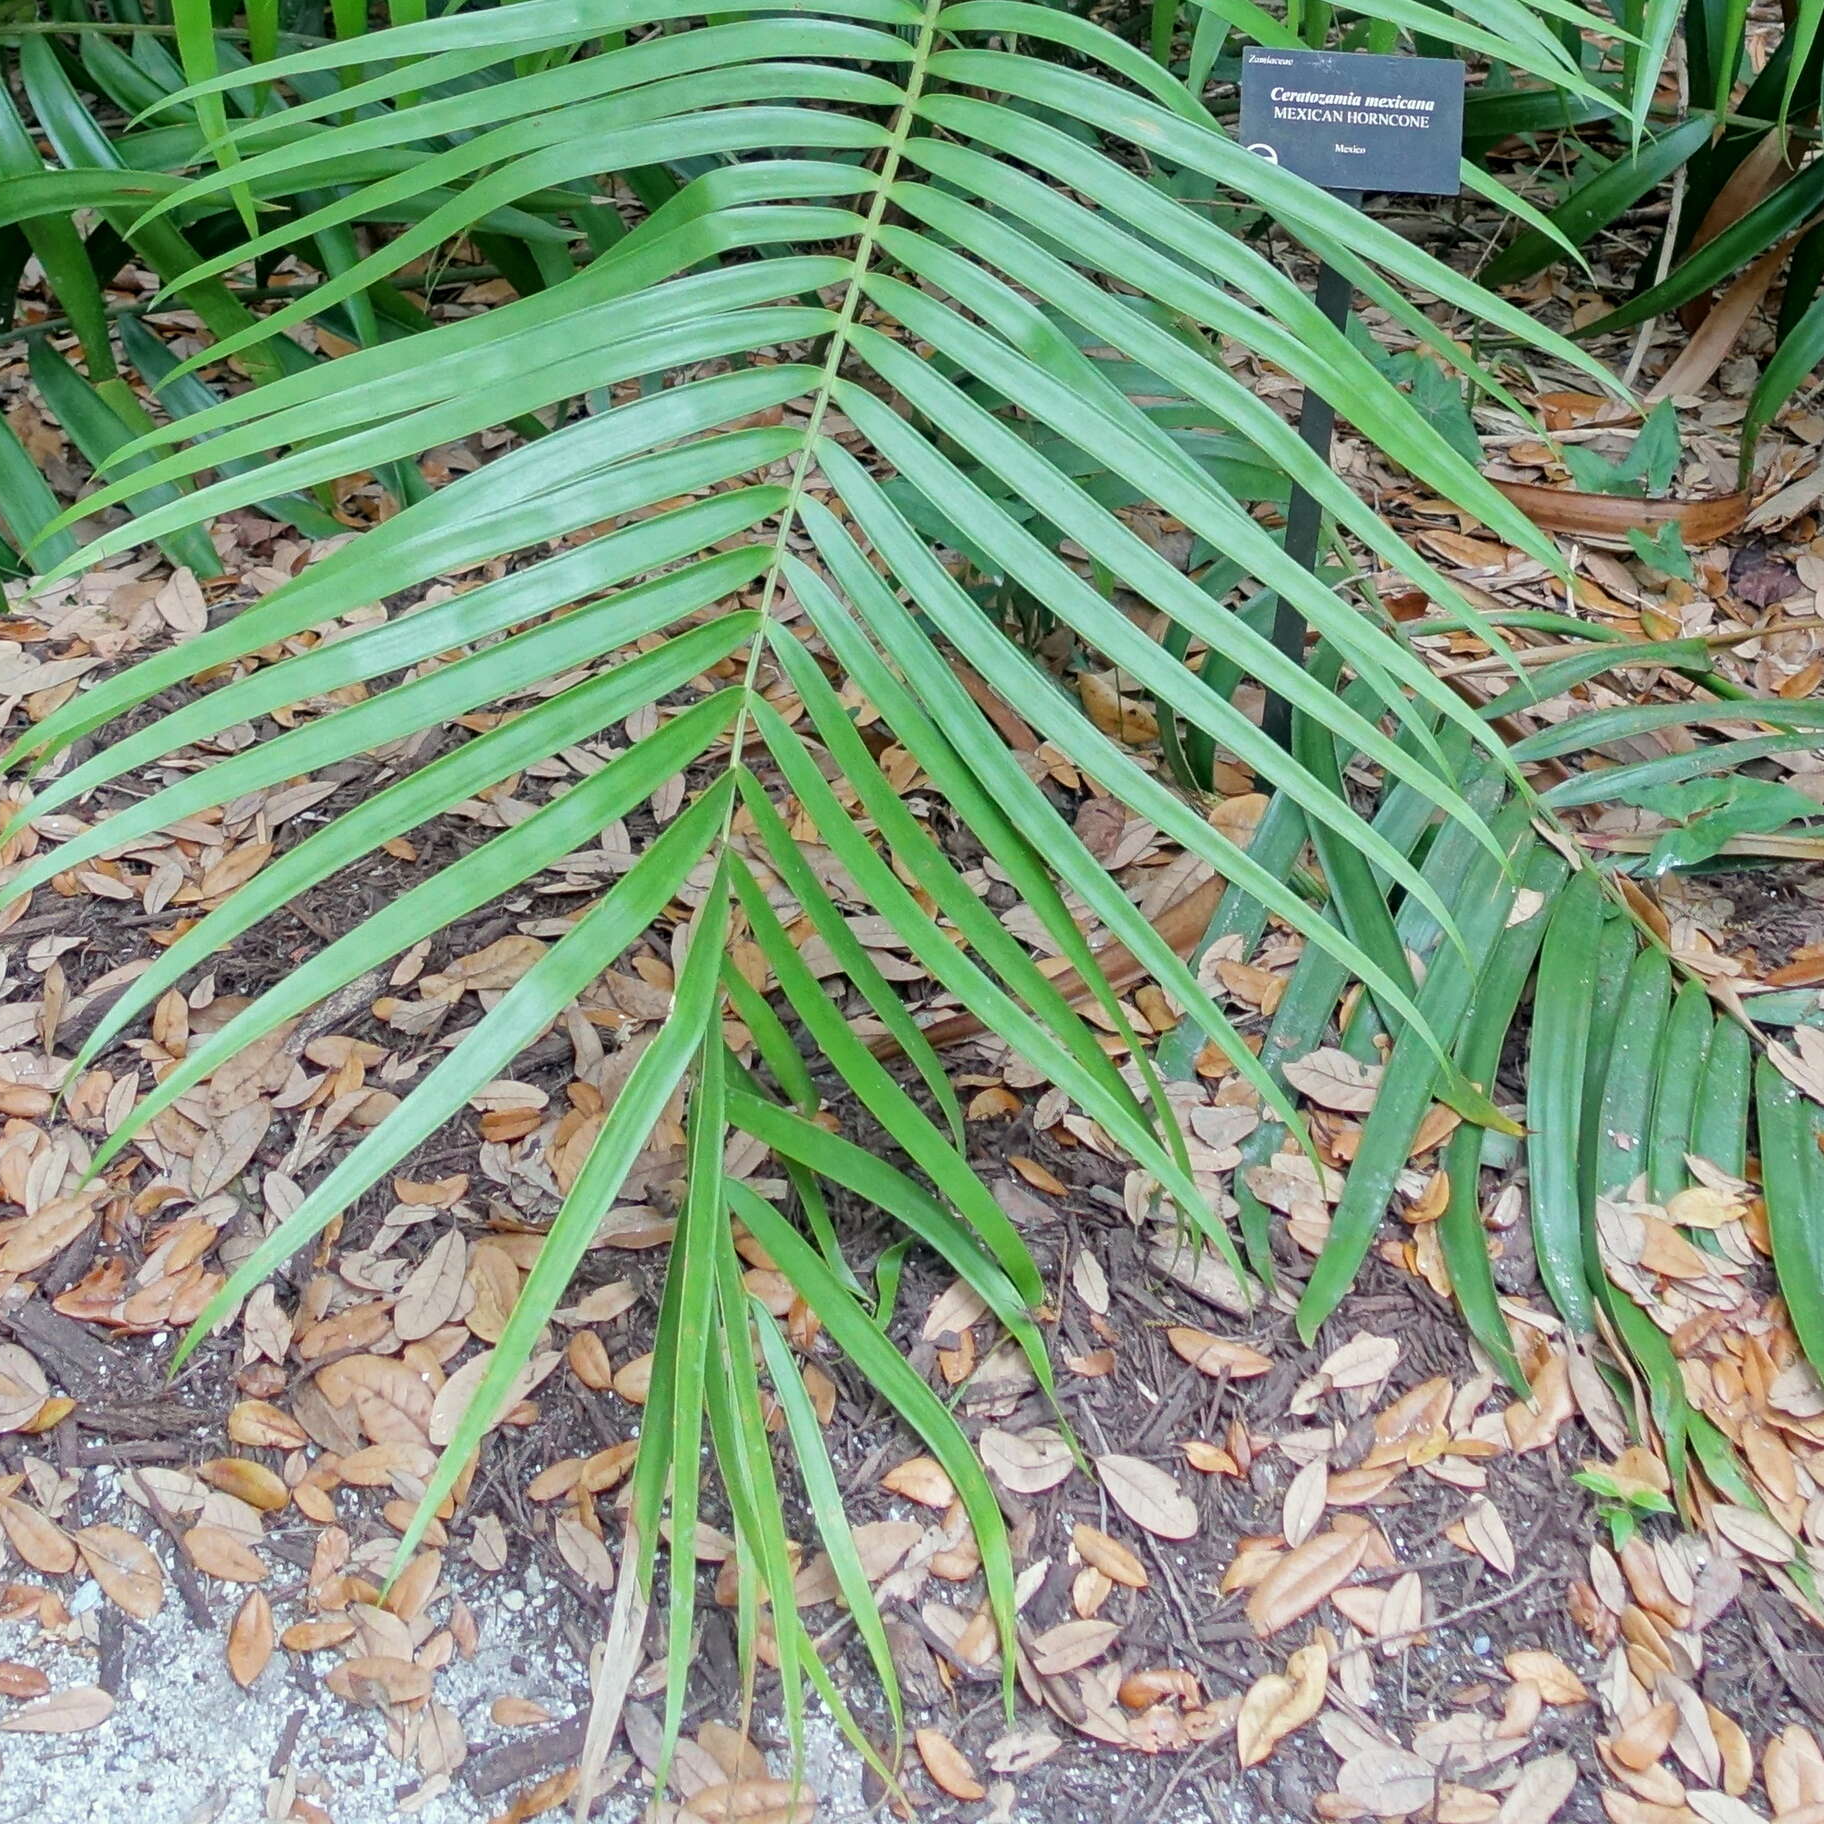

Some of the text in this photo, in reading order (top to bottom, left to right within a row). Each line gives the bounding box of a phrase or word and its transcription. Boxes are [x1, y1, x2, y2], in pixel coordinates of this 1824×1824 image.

[1248, 54, 1293, 66] Zamiaceae
[1271, 87, 1435, 111] Ceratozamia mexicana
[1274, 106, 1430, 129] MEXICAN HORNCONE
[1335, 143, 1366, 154] Mexico
